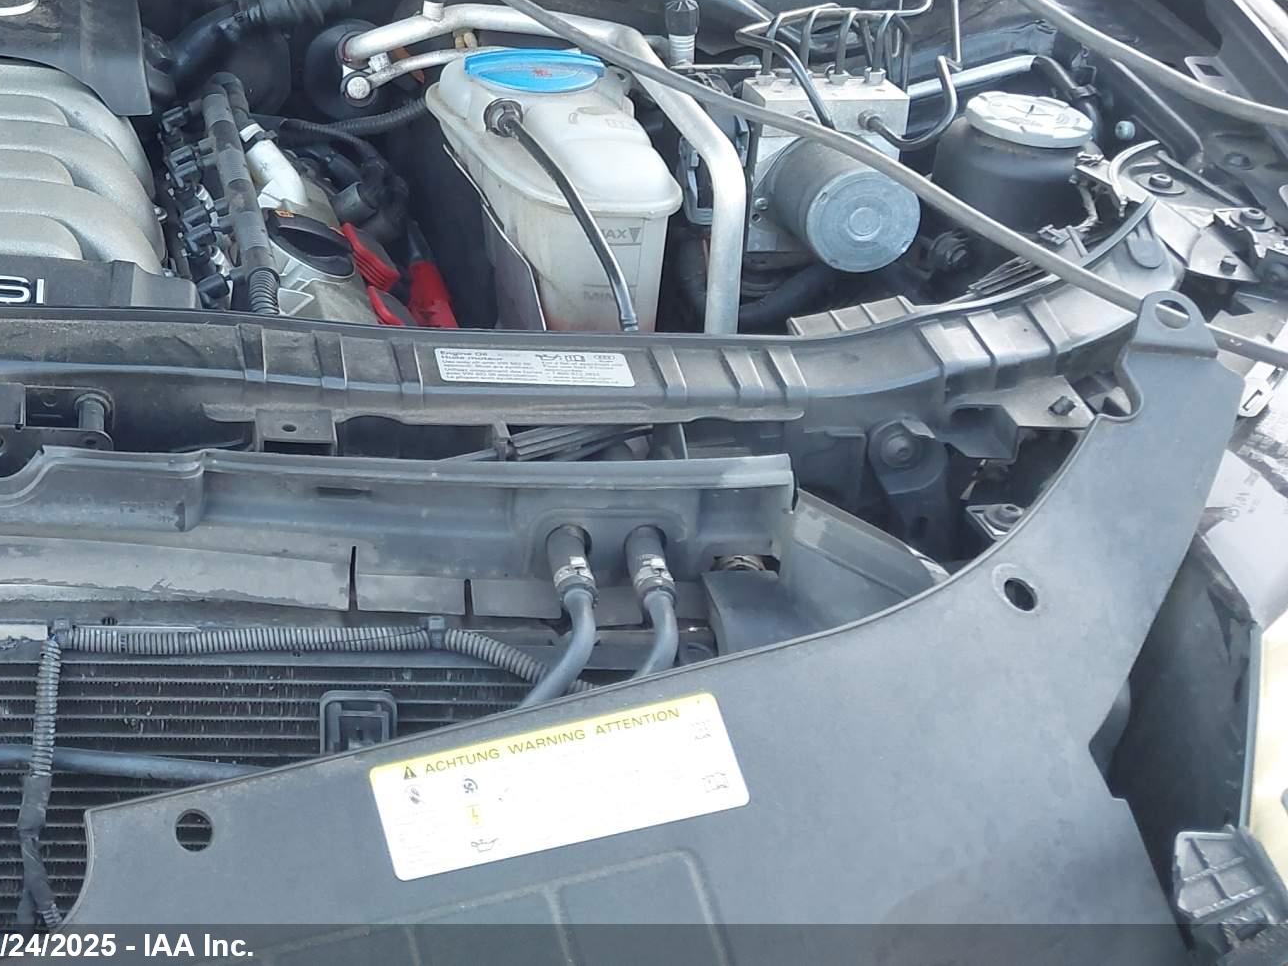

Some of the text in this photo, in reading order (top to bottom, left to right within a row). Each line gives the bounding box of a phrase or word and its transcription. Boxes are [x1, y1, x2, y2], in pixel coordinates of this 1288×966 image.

[601, 228, 627, 239] AX
[425, 708, 680, 775] ACHTUNG WARNING ATTENTION
